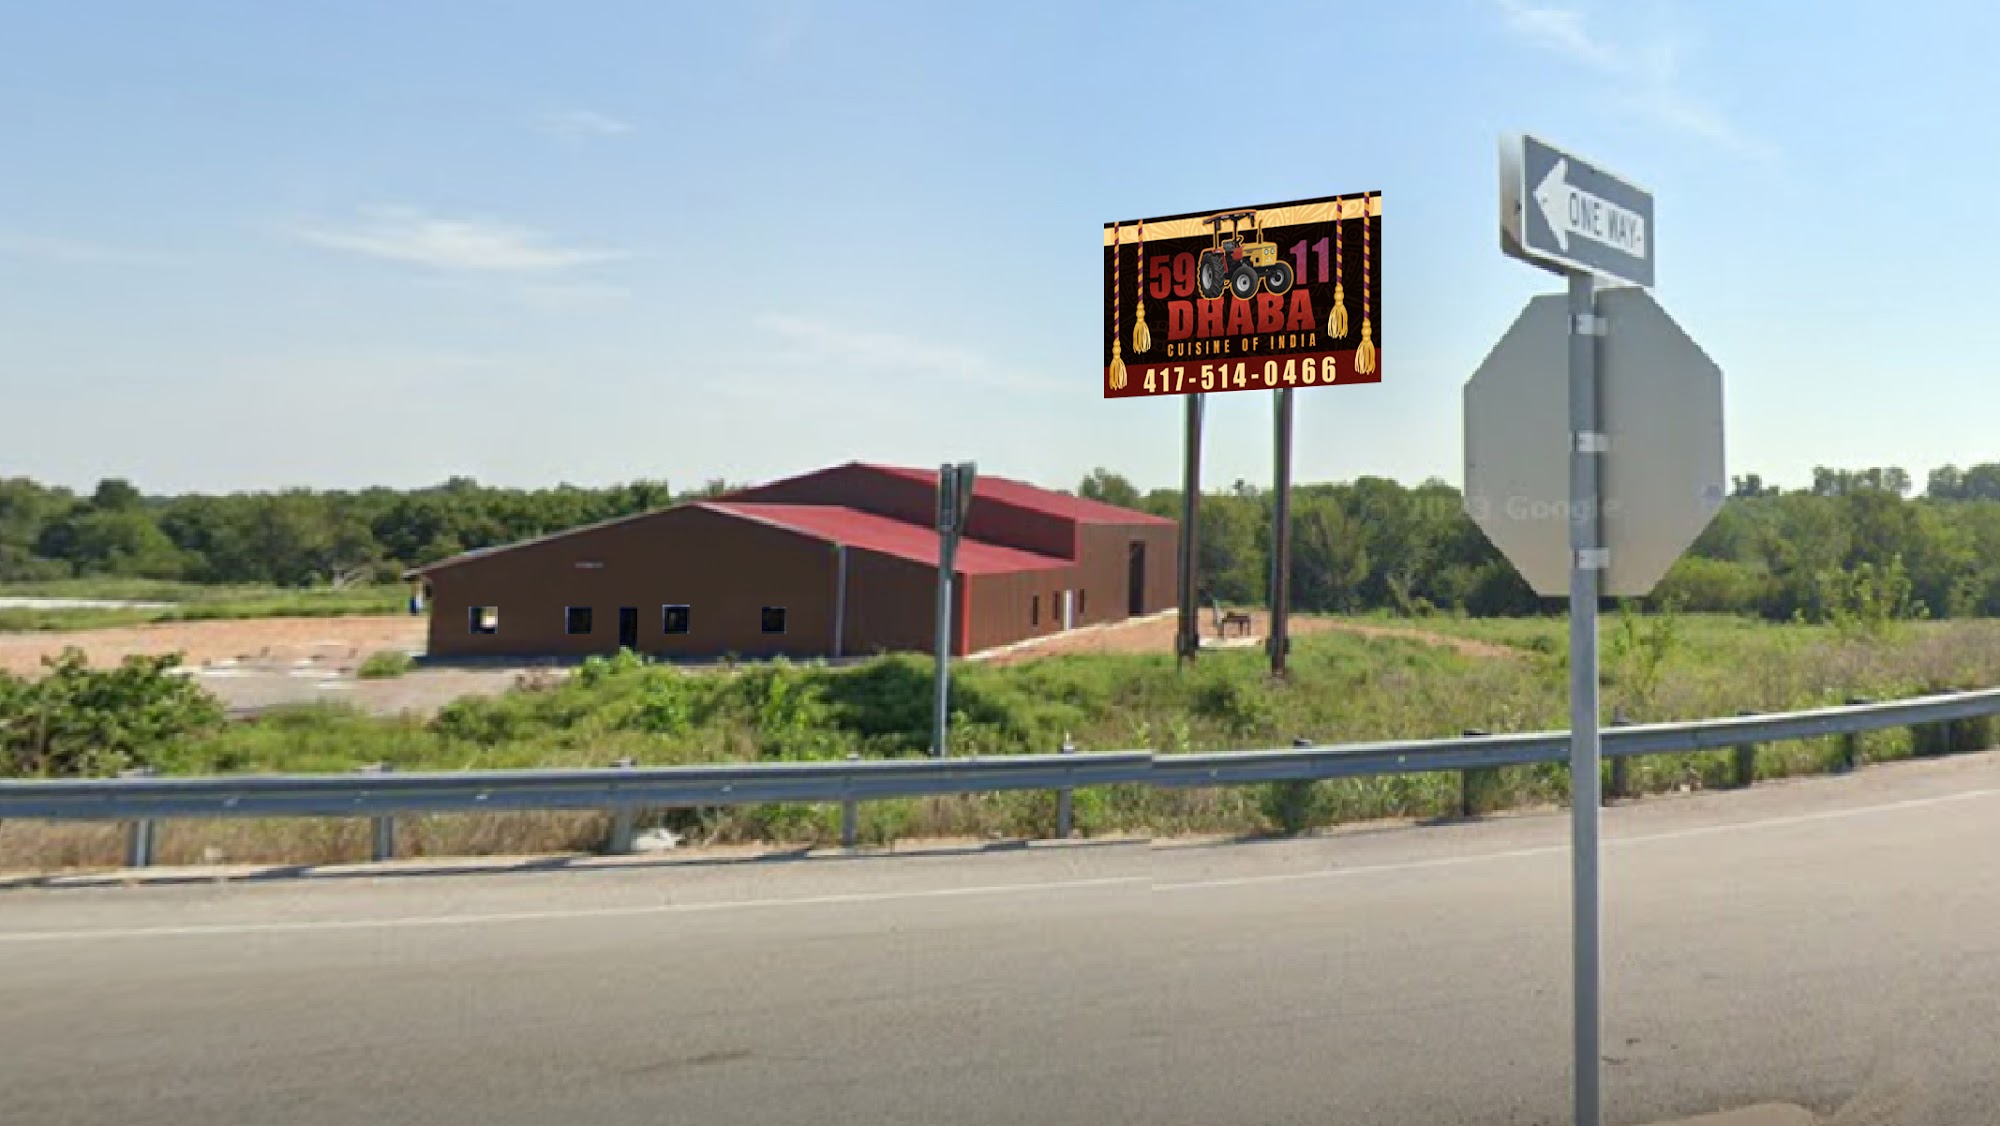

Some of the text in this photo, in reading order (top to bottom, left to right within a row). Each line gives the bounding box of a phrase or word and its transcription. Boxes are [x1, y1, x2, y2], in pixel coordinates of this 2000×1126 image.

[1569, 191, 1637, 249] ONE WAY
[1149, 237, 1330, 299] 59 11
[1167, 289, 1316, 341] DHABA
[1167, 332, 1317, 357] CUISINE OF INDIA
[1143, 356, 1337, 393] 417-514-0466
